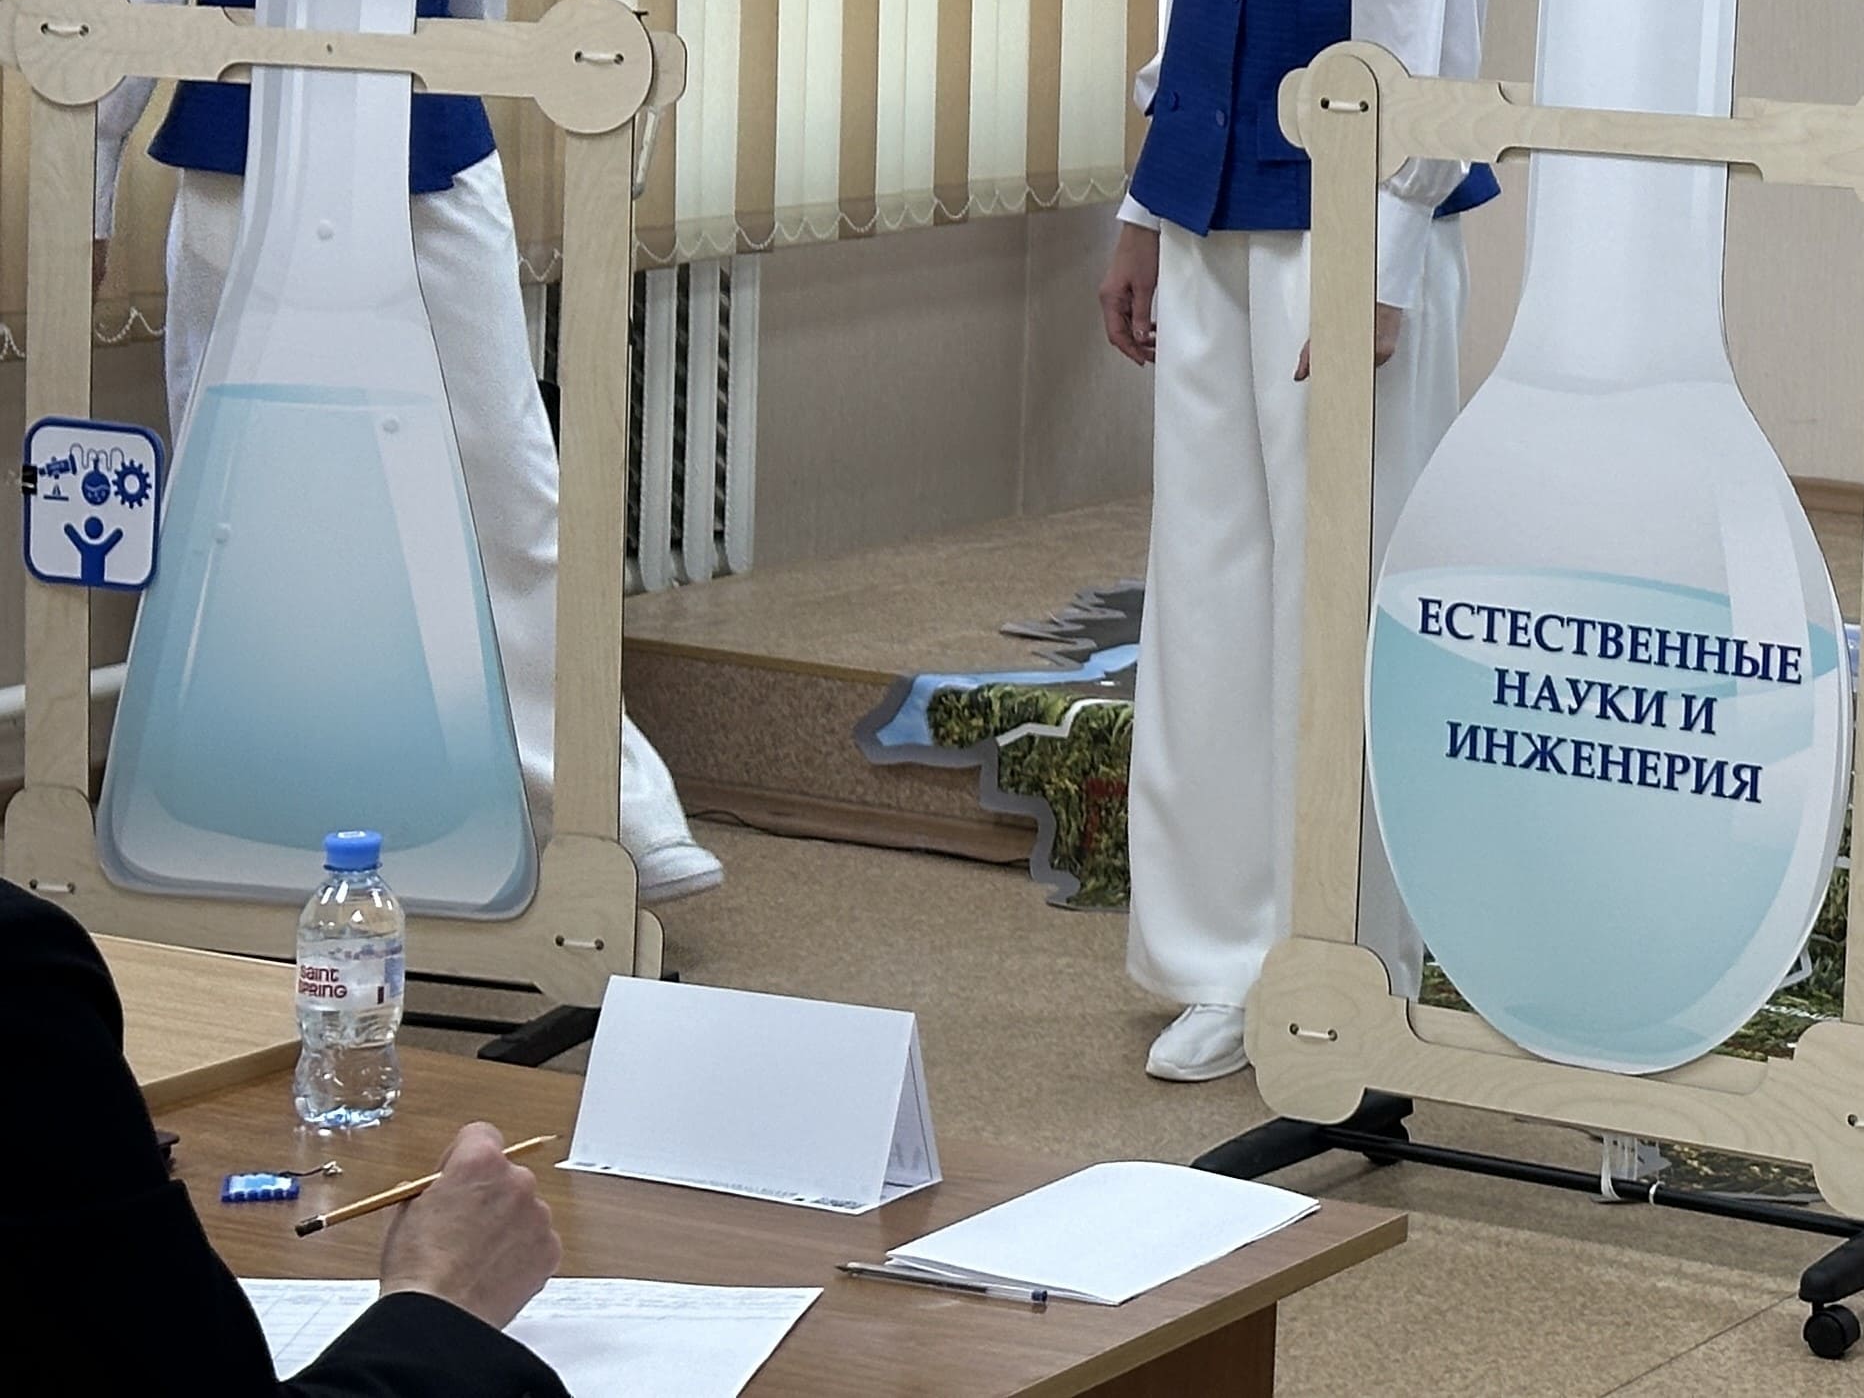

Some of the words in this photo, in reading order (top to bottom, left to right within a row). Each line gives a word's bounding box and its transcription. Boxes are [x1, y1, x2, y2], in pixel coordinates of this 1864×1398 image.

[1418, 597, 1803, 685] ЕСТЕСТВЕННЫЕ
[1492, 667, 1669, 729] НАУКИ
[1679, 693, 1718, 736] И
[1445, 720, 1763, 804] ИНЖЕНЕРИЯ
